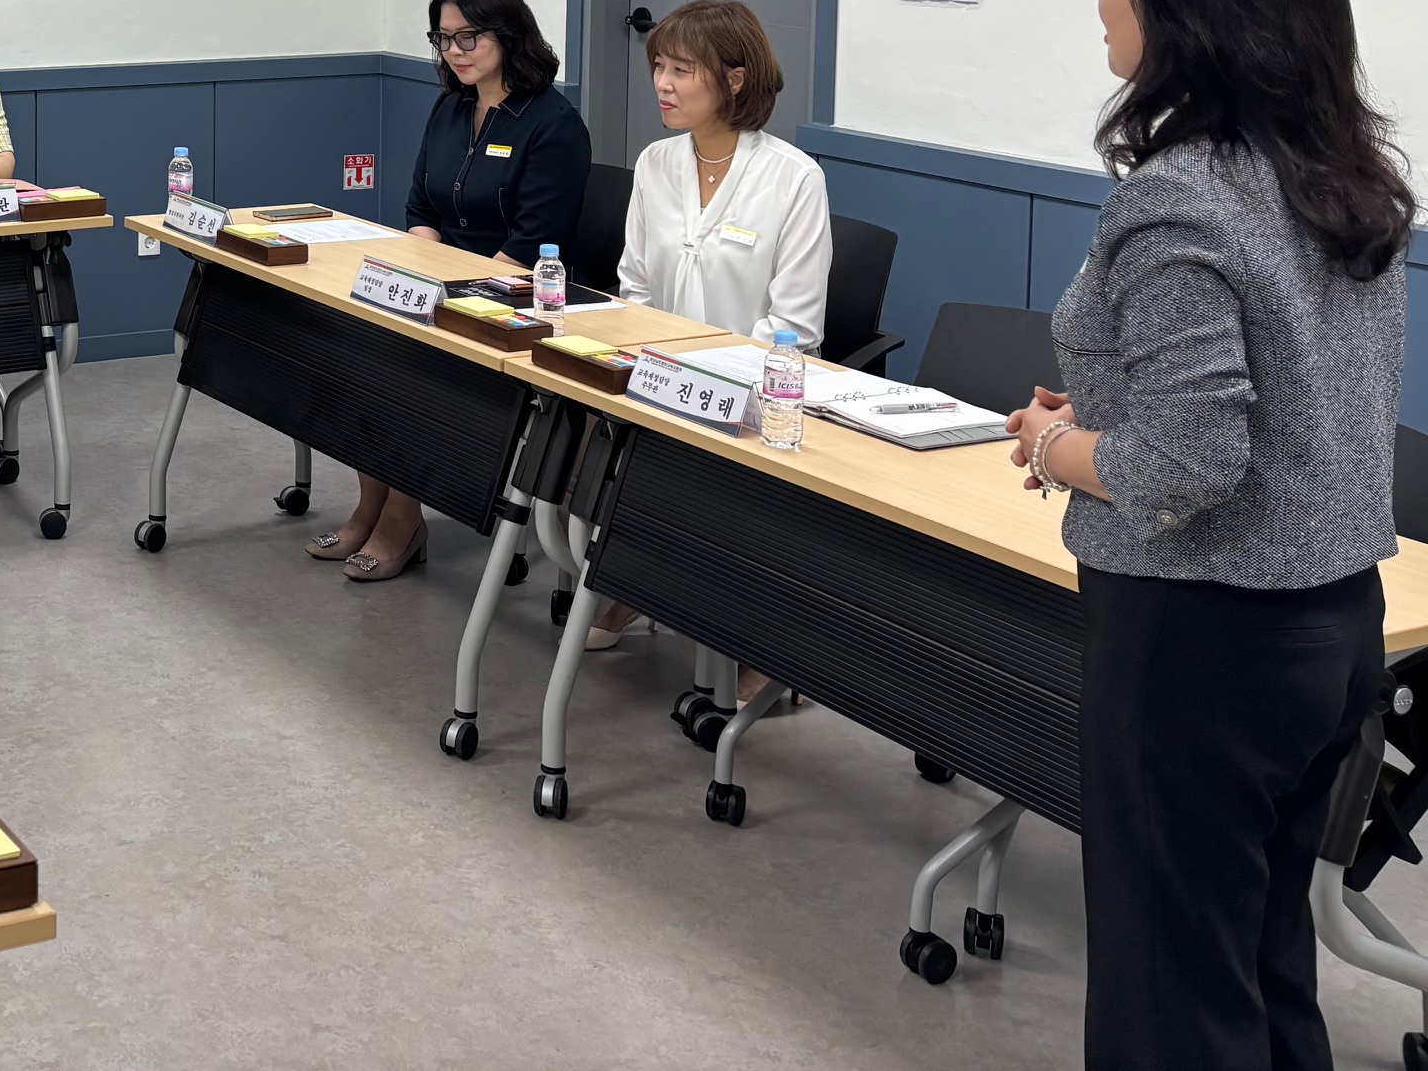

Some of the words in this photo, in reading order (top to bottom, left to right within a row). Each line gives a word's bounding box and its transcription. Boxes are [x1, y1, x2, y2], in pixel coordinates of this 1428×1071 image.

[346, 156, 372, 165] 소화기
[188, 211, 217, 233] 김순선
[388, 283, 428, 311] 안진화
[676, 382, 735, 420] 진영래
